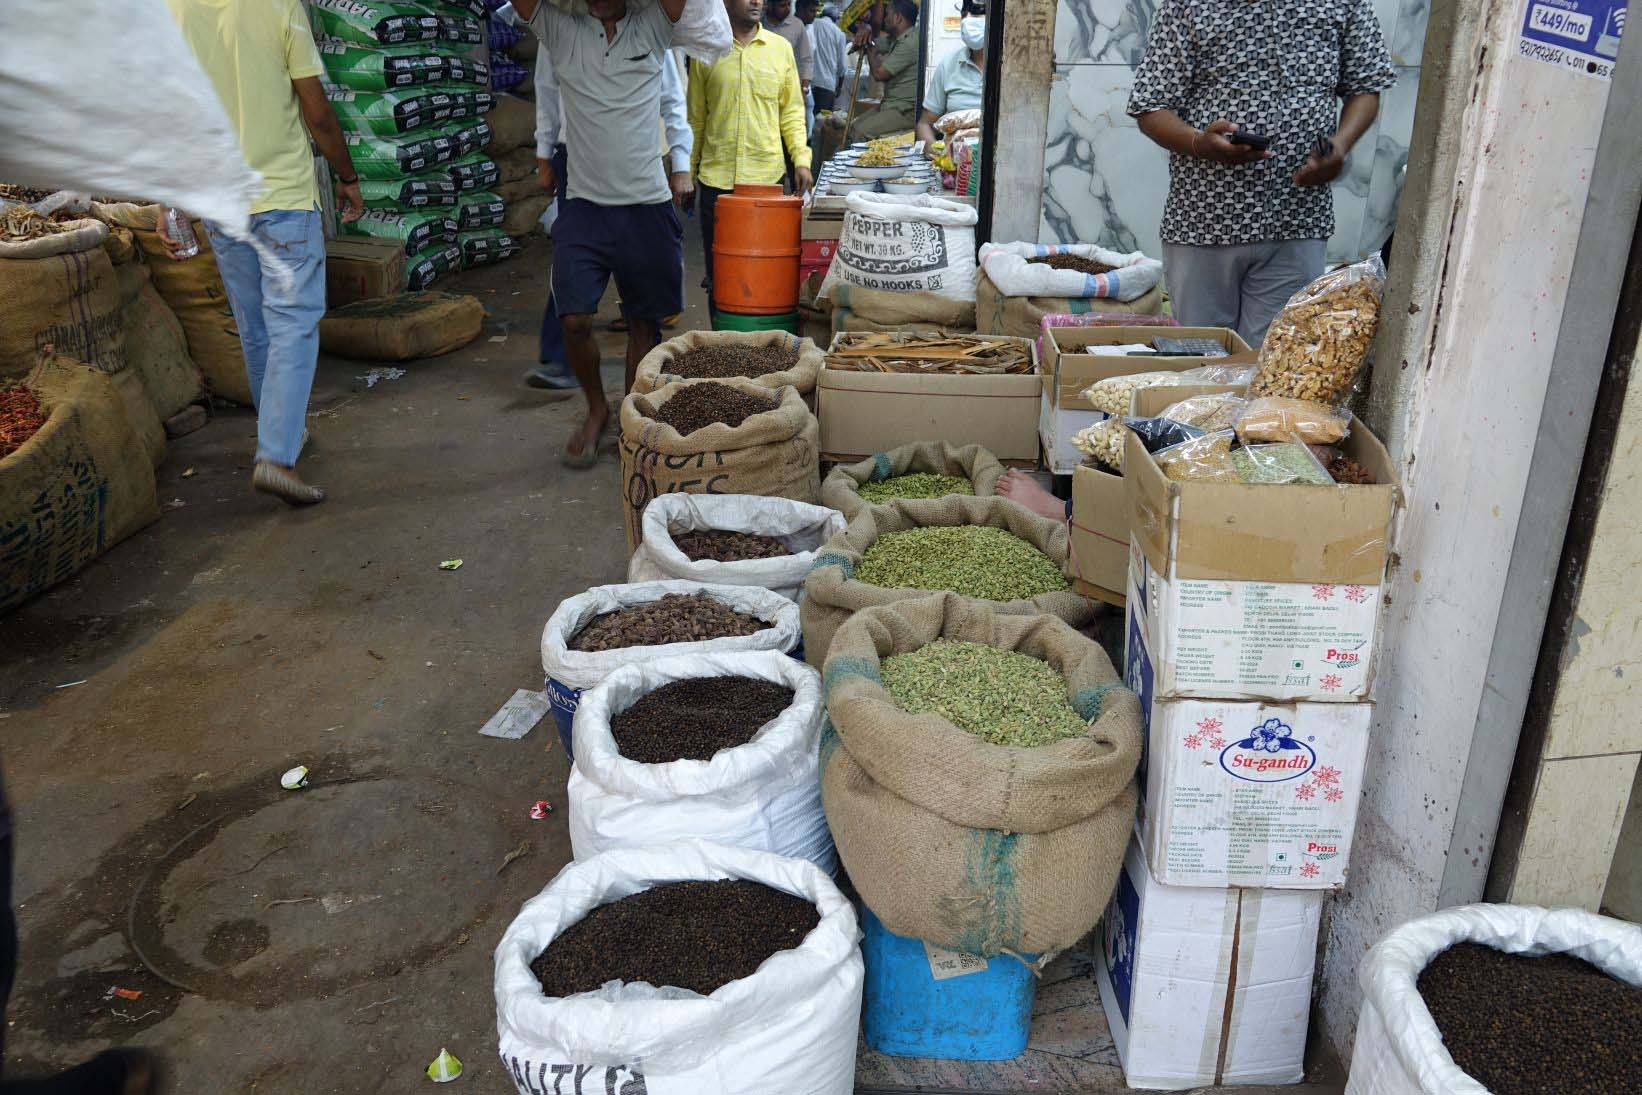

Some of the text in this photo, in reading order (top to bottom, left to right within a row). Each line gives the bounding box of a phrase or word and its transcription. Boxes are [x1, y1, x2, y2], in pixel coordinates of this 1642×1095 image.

[1536, 8, 1586, 36] ₹449/mo
[853, 215, 904, 237] PEPPER
[851, 238, 862, 251] NET
[844, 270, 923, 290] USE NO HOOKS
[1327, 649, 1359, 662] Prosi
[1231, 753, 1309, 773] Su-gandh
[1307, 842, 1337, 853] Prosi
